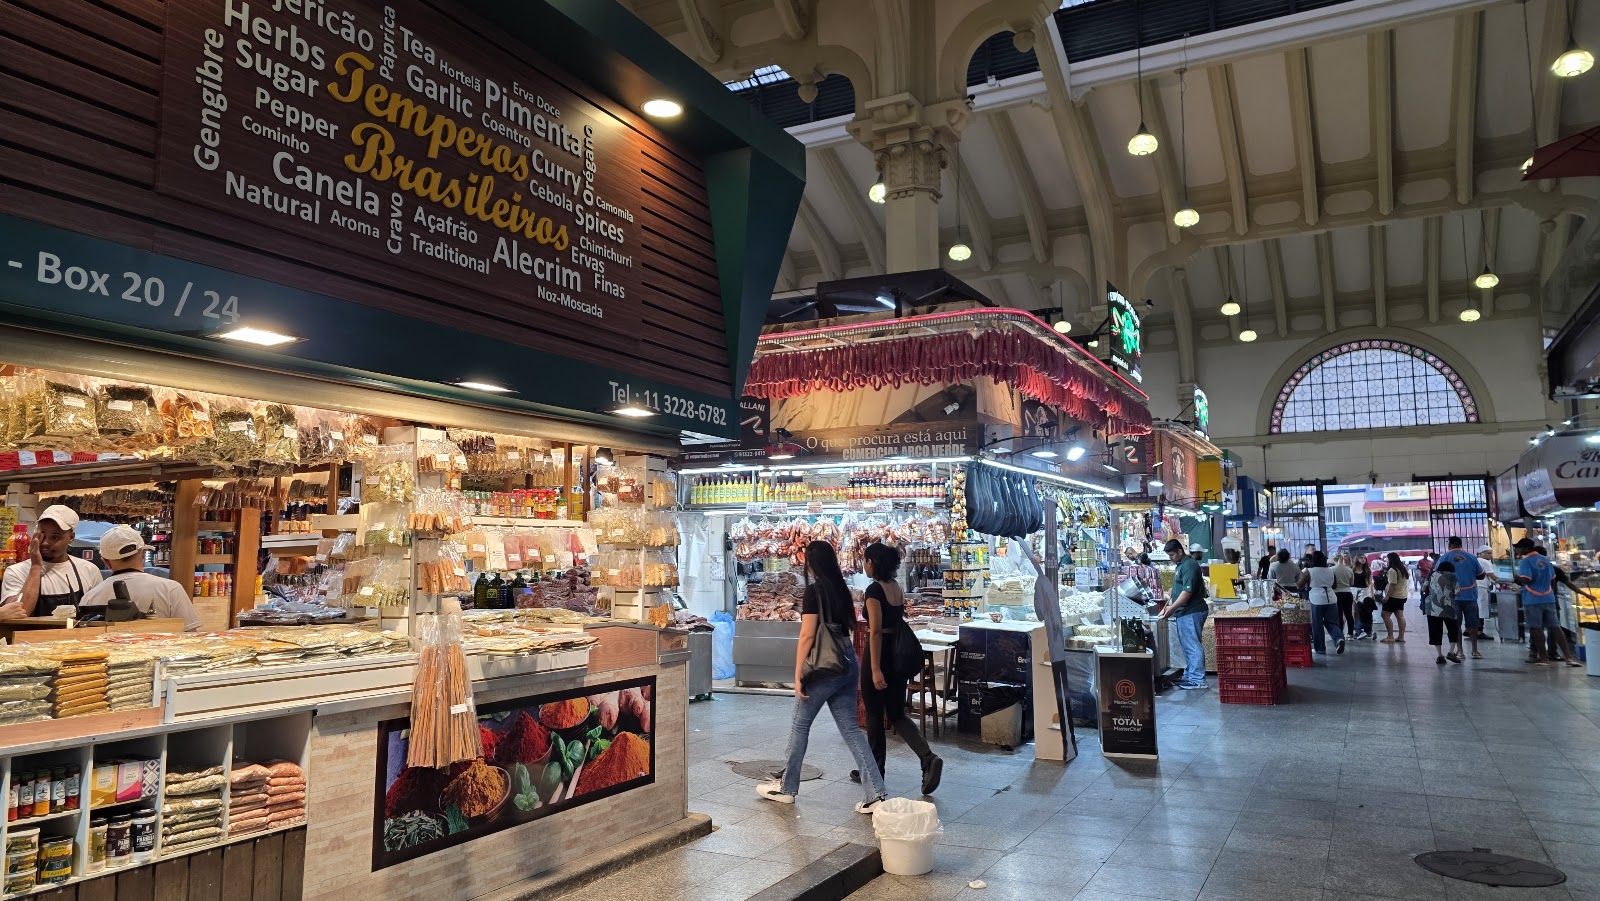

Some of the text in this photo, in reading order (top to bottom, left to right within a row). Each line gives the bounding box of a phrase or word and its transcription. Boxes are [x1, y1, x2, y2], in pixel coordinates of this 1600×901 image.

[224, 0, 326, 71] Herbs
[379, 5, 396, 82] Páprica
[399, 26, 436, 66] Tea
[235, 39, 319, 97] Sugar
[439, 59, 481, 92] Hortelã
[193, 28, 228, 171] Gengibre
[406, 64, 473, 118] Garlic
[513, 81, 561, 119] Erva Doce
[255, 87, 339, 140] Pepper
[327, 51, 529, 182] Temperos
[482, 112, 531, 148] Coentro
[485, 78, 582, 158] Pimenta
[241, 115, 310, 154] Cominho
[272, 151, 380, 216] Canela
[531, 149, 582, 195] Curry
[583, 124, 596, 206] Orégano
[225, 170, 321, 224] Natural
[344, 122, 569, 251] Brasileiros
[529, 179, 573, 213] Cebola
[330, 209, 380, 239] Aroma
[387, 192, 403, 254] Cravo
[414, 205, 478, 244] Açafrão
[575, 204, 625, 244] Spices
[596, 196, 634, 223] Camomila
[410, 233, 490, 275] Traditional
[492, 236, 582, 292] Alecrim
[571, 245, 605, 274] Ervas
[579, 236, 632, 268] Chimichurri
[37, 251, 110, 297] Box
[121, 272, 165, 307] 20
[173, 281, 194, 317] /
[203, 290, 240, 323] 24
[537, 285, 603, 319] Noz-Moscada
[594, 273, 625, 299] Finas
[644, 390, 660, 411] 11
[664, 394, 727, 426] 3228-6782
[806, 427, 967, 452] O que procura está aqui
[842, 443, 966, 461] COMERCIAL ARCO VERDE
[1112, 717, 1143, 727] TOTAL
